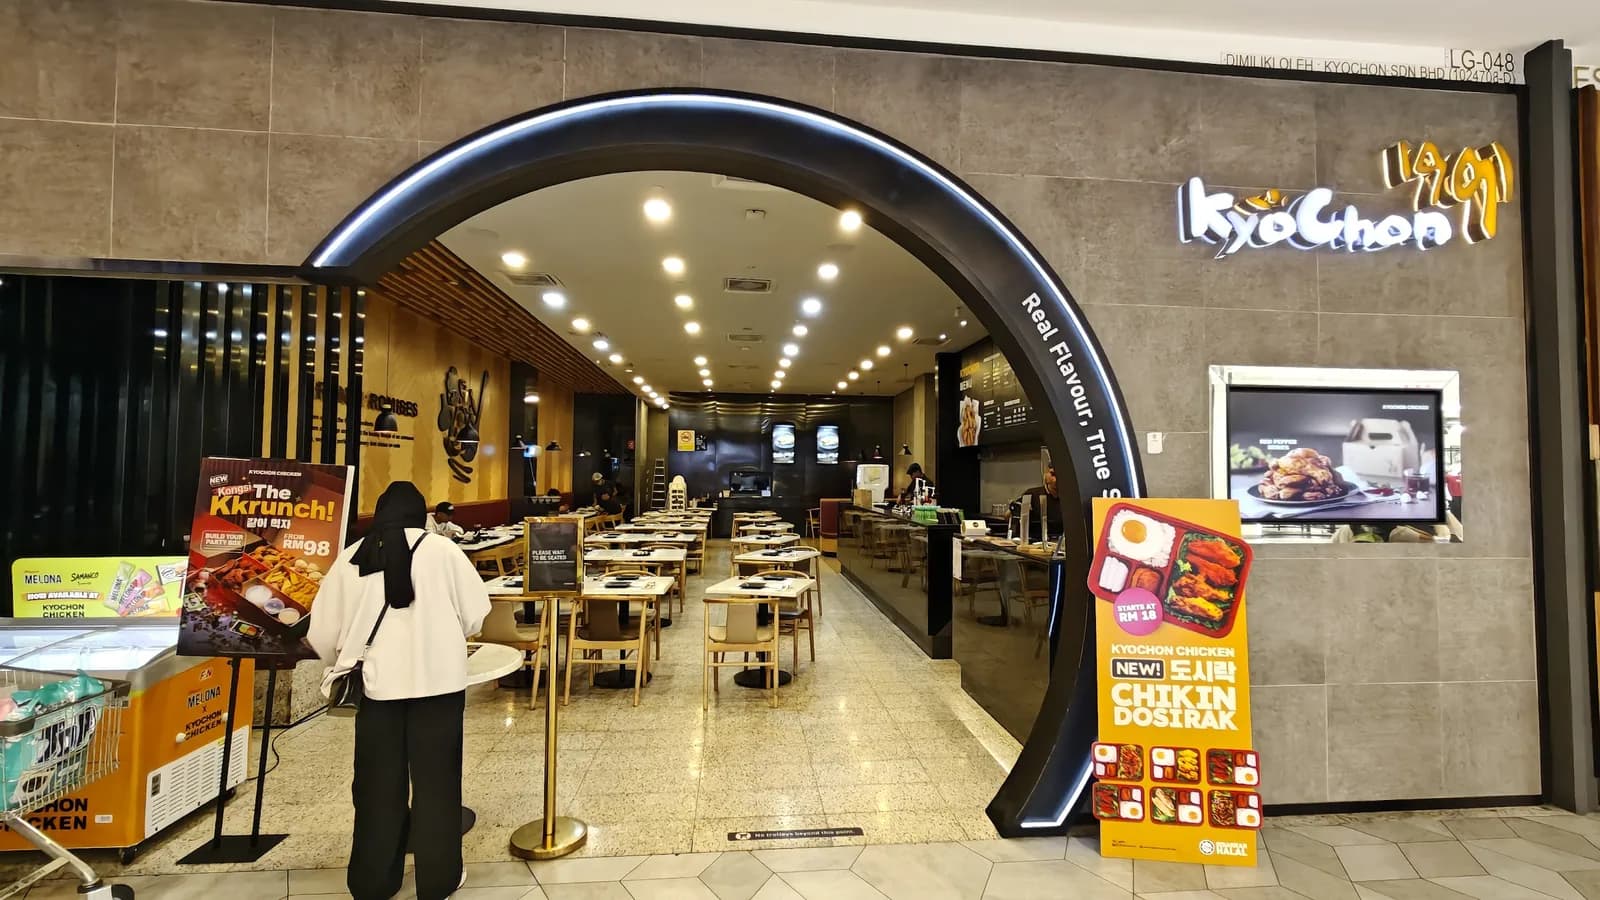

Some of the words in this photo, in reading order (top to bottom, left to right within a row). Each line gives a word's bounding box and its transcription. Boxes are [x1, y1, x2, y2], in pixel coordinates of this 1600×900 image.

[1324, 60, 1386, 76] KYOCHON
[1390, 64, 1417, 78] SDN
[1420, 66, 1445, 80] BHD
[1450, 50, 1515, 72] LG-048
[1021, 292, 1059, 341] Real
[1049, 340, 1093, 427] Flavour,
[1086, 429, 1111, 480] True
[209, 474, 228, 484] NEW
[217, 482, 252, 497] Kongsi
[253, 483, 292, 500] The
[209, 495, 335, 522] Kkrunch!
[24, 575, 62, 584] MELONA
[71, 572, 99, 582] SAMANCO
[1119, 612, 1138, 622] RM
[1141, 610, 1157, 621] 18
[1111, 644, 1174, 656] KYOCHON
[1176, 646, 1235, 657] CHICKEN
[1116, 661, 1161, 676] NEW!
[1170, 659, 1237, 683] 도시락
[188, 686, 221, 708] MELONA
[1111, 682, 1236, 711] CHIKIN
[185, 710, 222, 731] KYOCHON
[1114, 706, 1239, 731] DOSIRAK
[184, 719, 222, 741] CHICKEN
